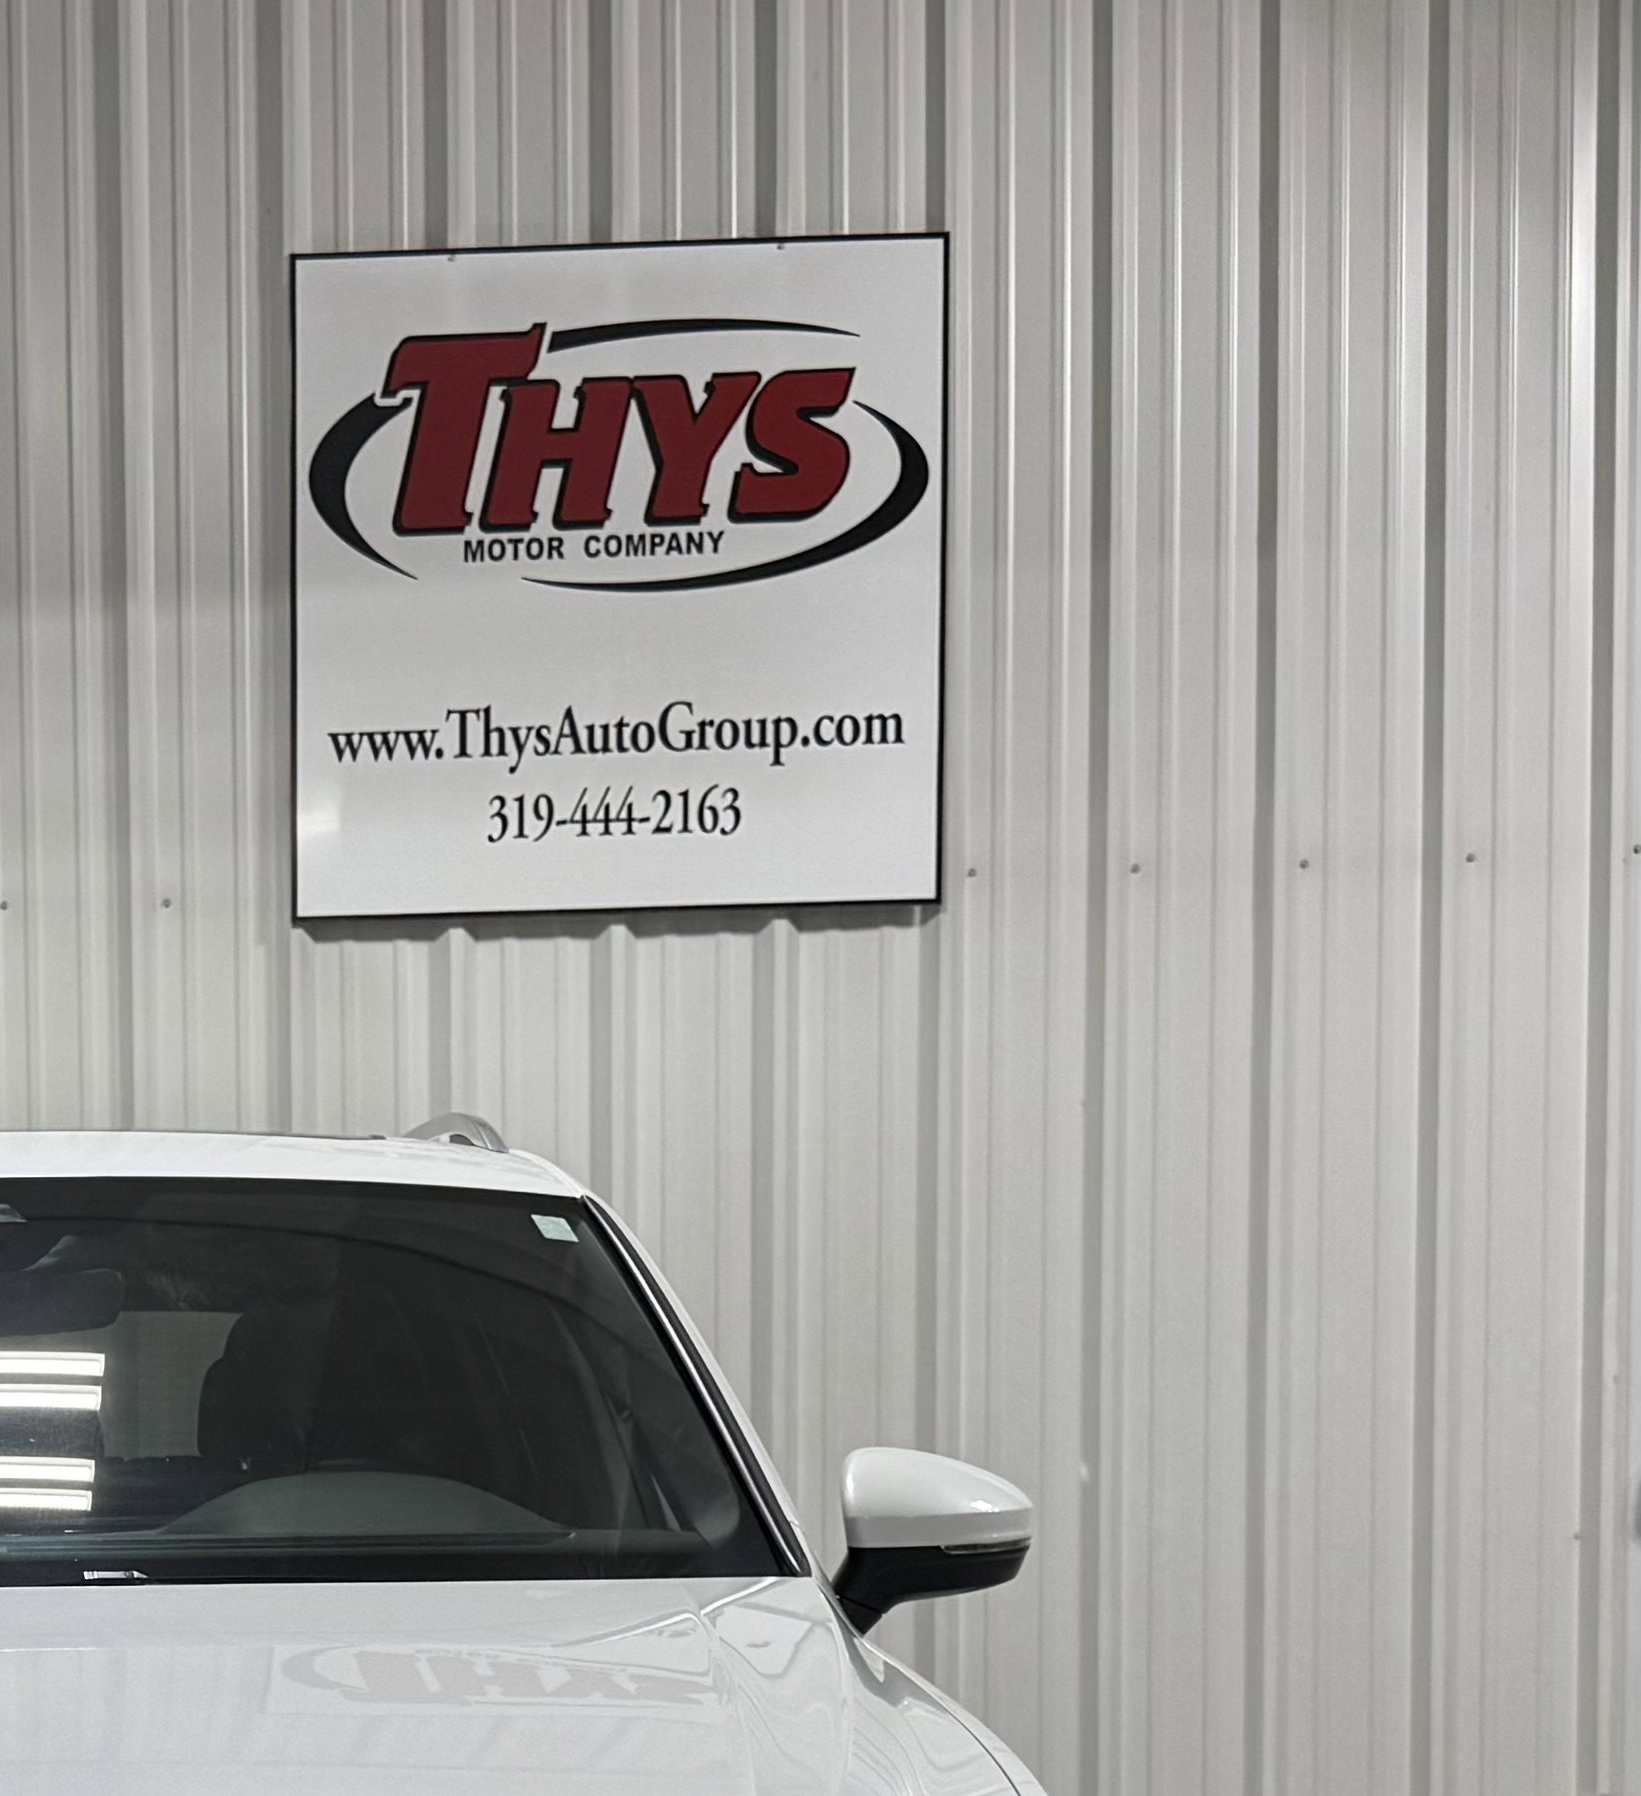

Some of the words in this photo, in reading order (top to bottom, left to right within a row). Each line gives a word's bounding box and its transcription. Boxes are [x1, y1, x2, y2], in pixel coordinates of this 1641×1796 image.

[381, 322, 856, 536] THYS
[462, 537, 565, 563] MOTOR
[583, 531, 725, 559] COMPANY
[328, 701, 905, 774] www.ThysAutoGroup.com
[487, 784, 743, 843] 319-444-2163
